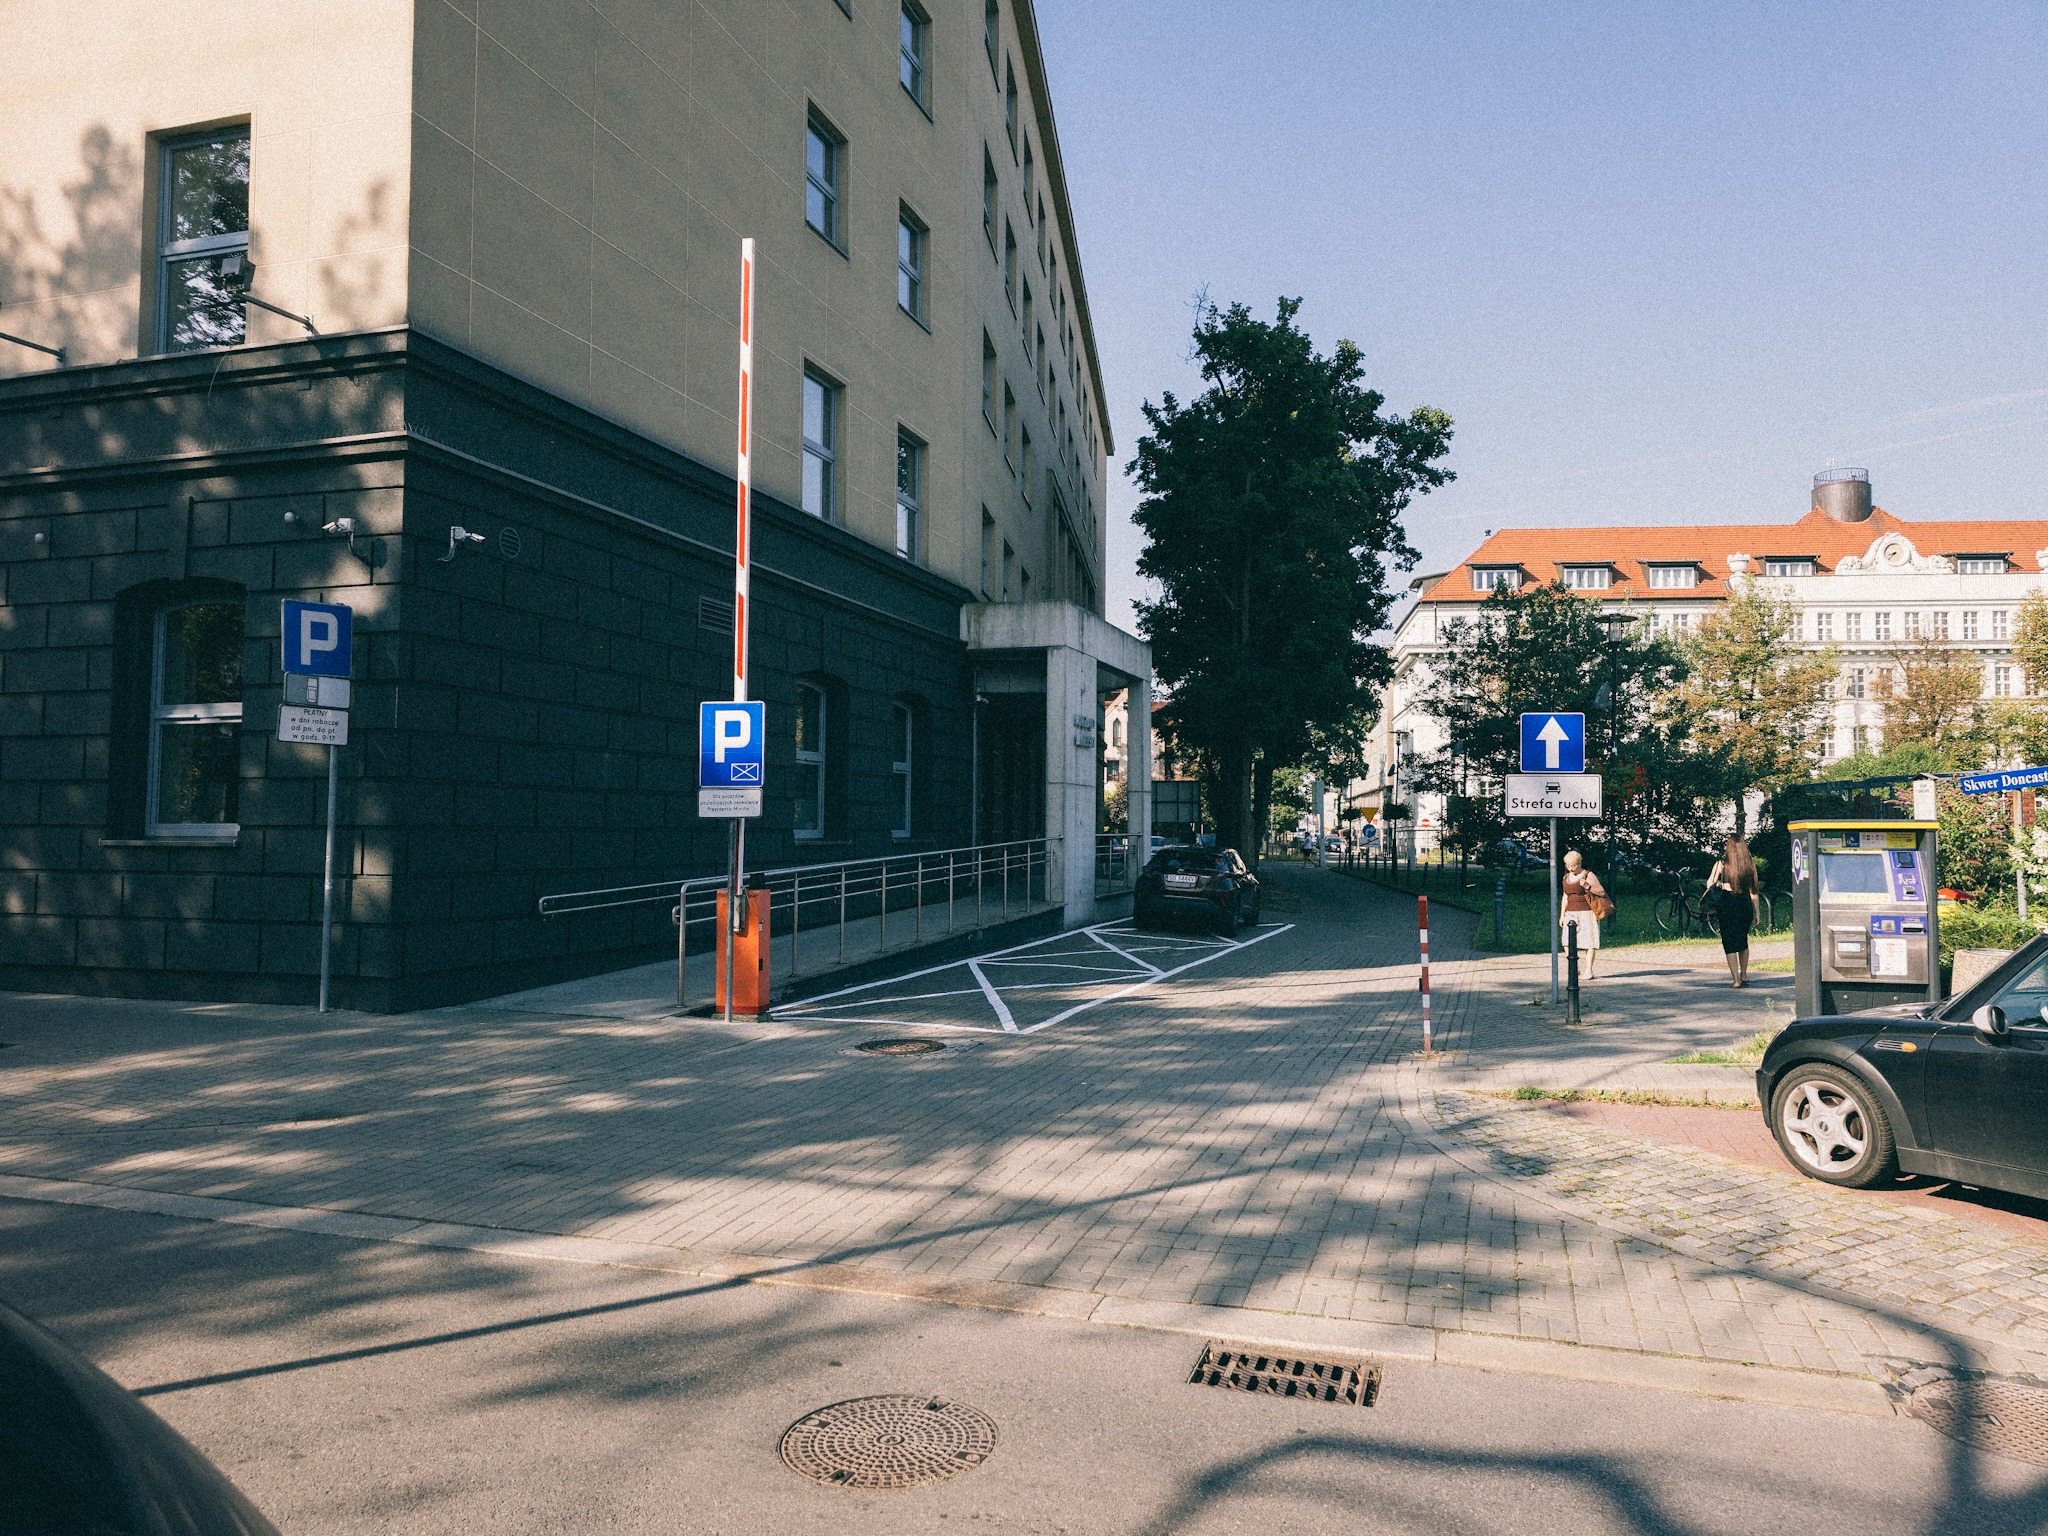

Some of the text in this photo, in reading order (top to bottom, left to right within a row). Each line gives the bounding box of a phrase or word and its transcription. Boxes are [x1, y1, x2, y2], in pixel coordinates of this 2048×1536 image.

[300, 609, 339, 666] P
[312, 718, 339, 726] robocze
[714, 710, 751, 763] P
[1963, 779, 1999, 791] Skwer
[1511, 797, 1597, 809] Strefa ruchu
